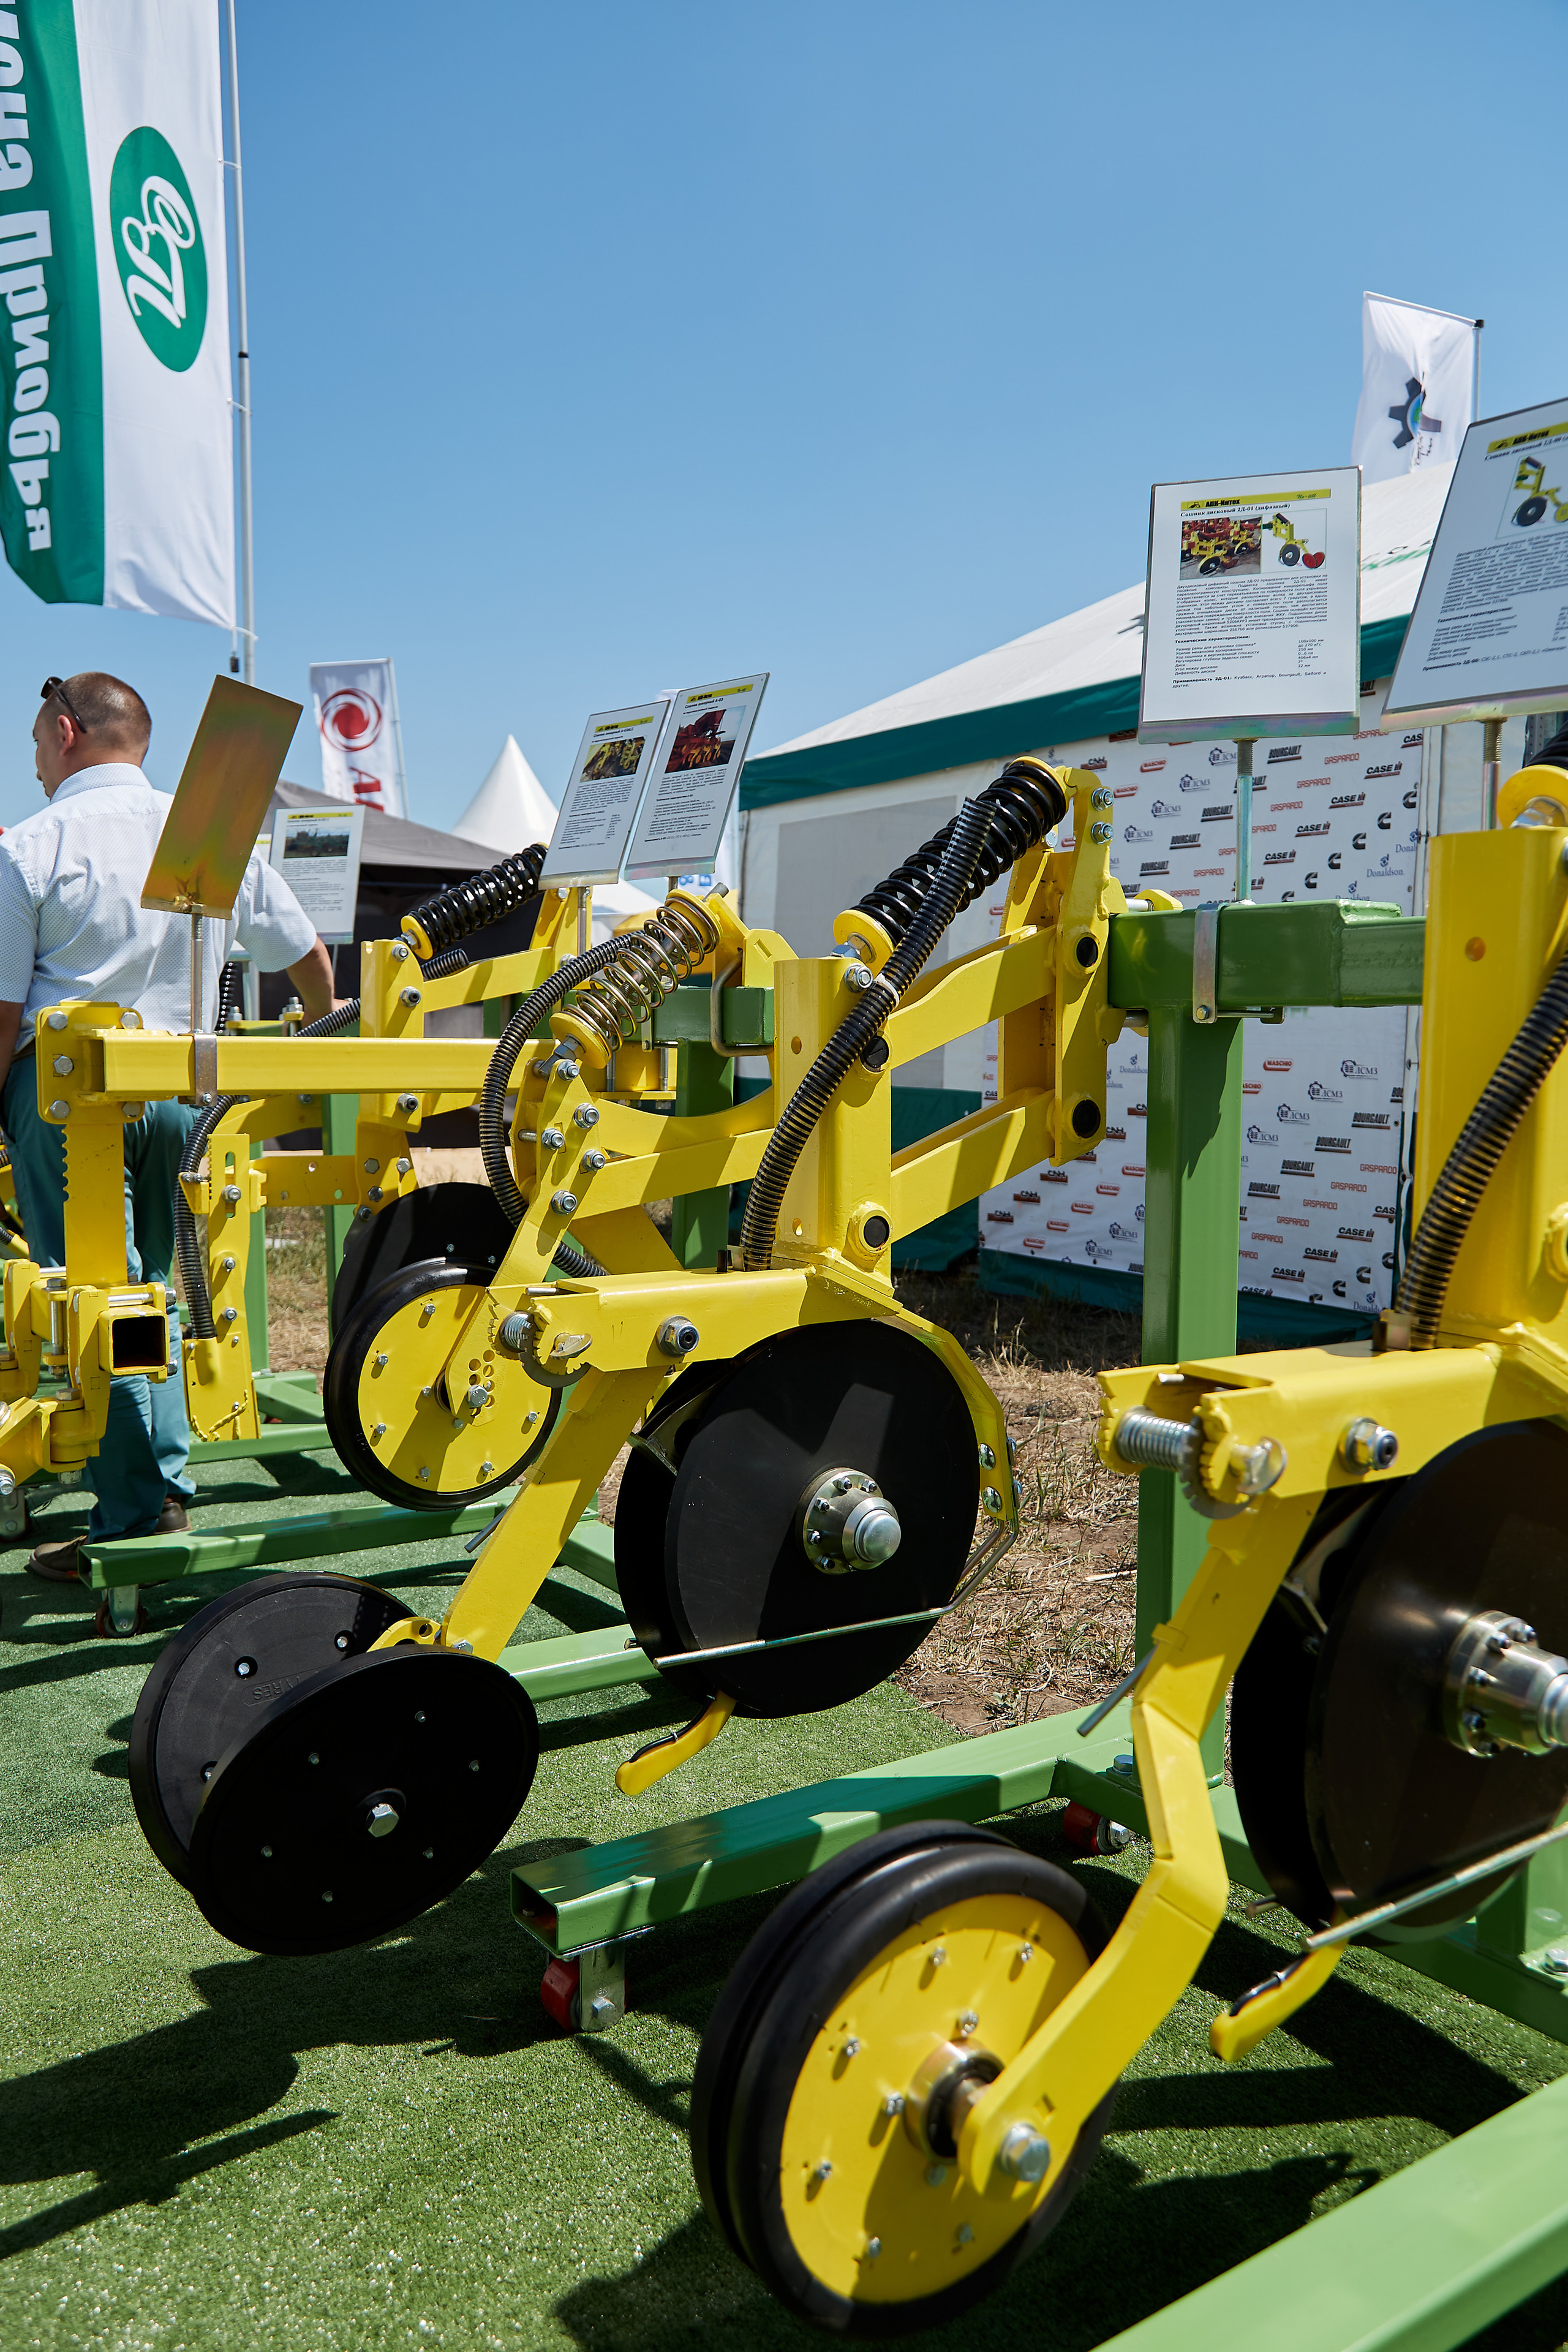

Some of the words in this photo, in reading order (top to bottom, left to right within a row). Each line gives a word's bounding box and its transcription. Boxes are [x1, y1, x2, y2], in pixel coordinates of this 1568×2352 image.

[0, 211, 60, 551] Приобья
[1403, 733, 1422, 743] CAS
[1268, 745, 1302, 758] BOURGAULT
[1324, 753, 1359, 764] GASPARDO
[1366, 764, 1393, 774] CASE
[1297, 777, 1330, 788] GASPARDO
[1331, 795, 1357, 804] CASE
[1202, 805, 1233, 817] BOURGAULT
[1270, 801, 1303, 812] GASPARDO
[1252, 824, 1276, 834] SPARDO
[1297, 824, 1321, 832] CASE
[1171, 833, 1200, 845] BOURGAULT
[1140, 861, 1169, 872] BOURGAULT
[1194, 868, 1224, 876] GASPARDO
[1170, 889, 1200, 897] GASPARDO
[1352, 1112, 1390, 1124] BOURGAULT
[1316, 1136, 1351, 1148] BOURGAULT
[1281, 1159, 1314, 1172] BOURGAULT
[1360, 1163, 1396, 1174] GASPARDO
[1249, 1182, 1280, 1194] BOURGAULT
[1331, 1182, 1367, 1192] GASPARDO
[1303, 1199, 1338, 1210] GASPARDO
[1375, 1205, 1396, 1215] CAS
[1277, 1216, 1309, 1227] GASPARDO
[1251, 1232, 1283, 1243] GASPARDO
[1339, 1227, 1365, 1237] CASE
[1238, 1250, 1258, 1259] PARDO
[1305, 1247, 1330, 1257] CASE
[1273, 1267, 1297, 1277] CASE
